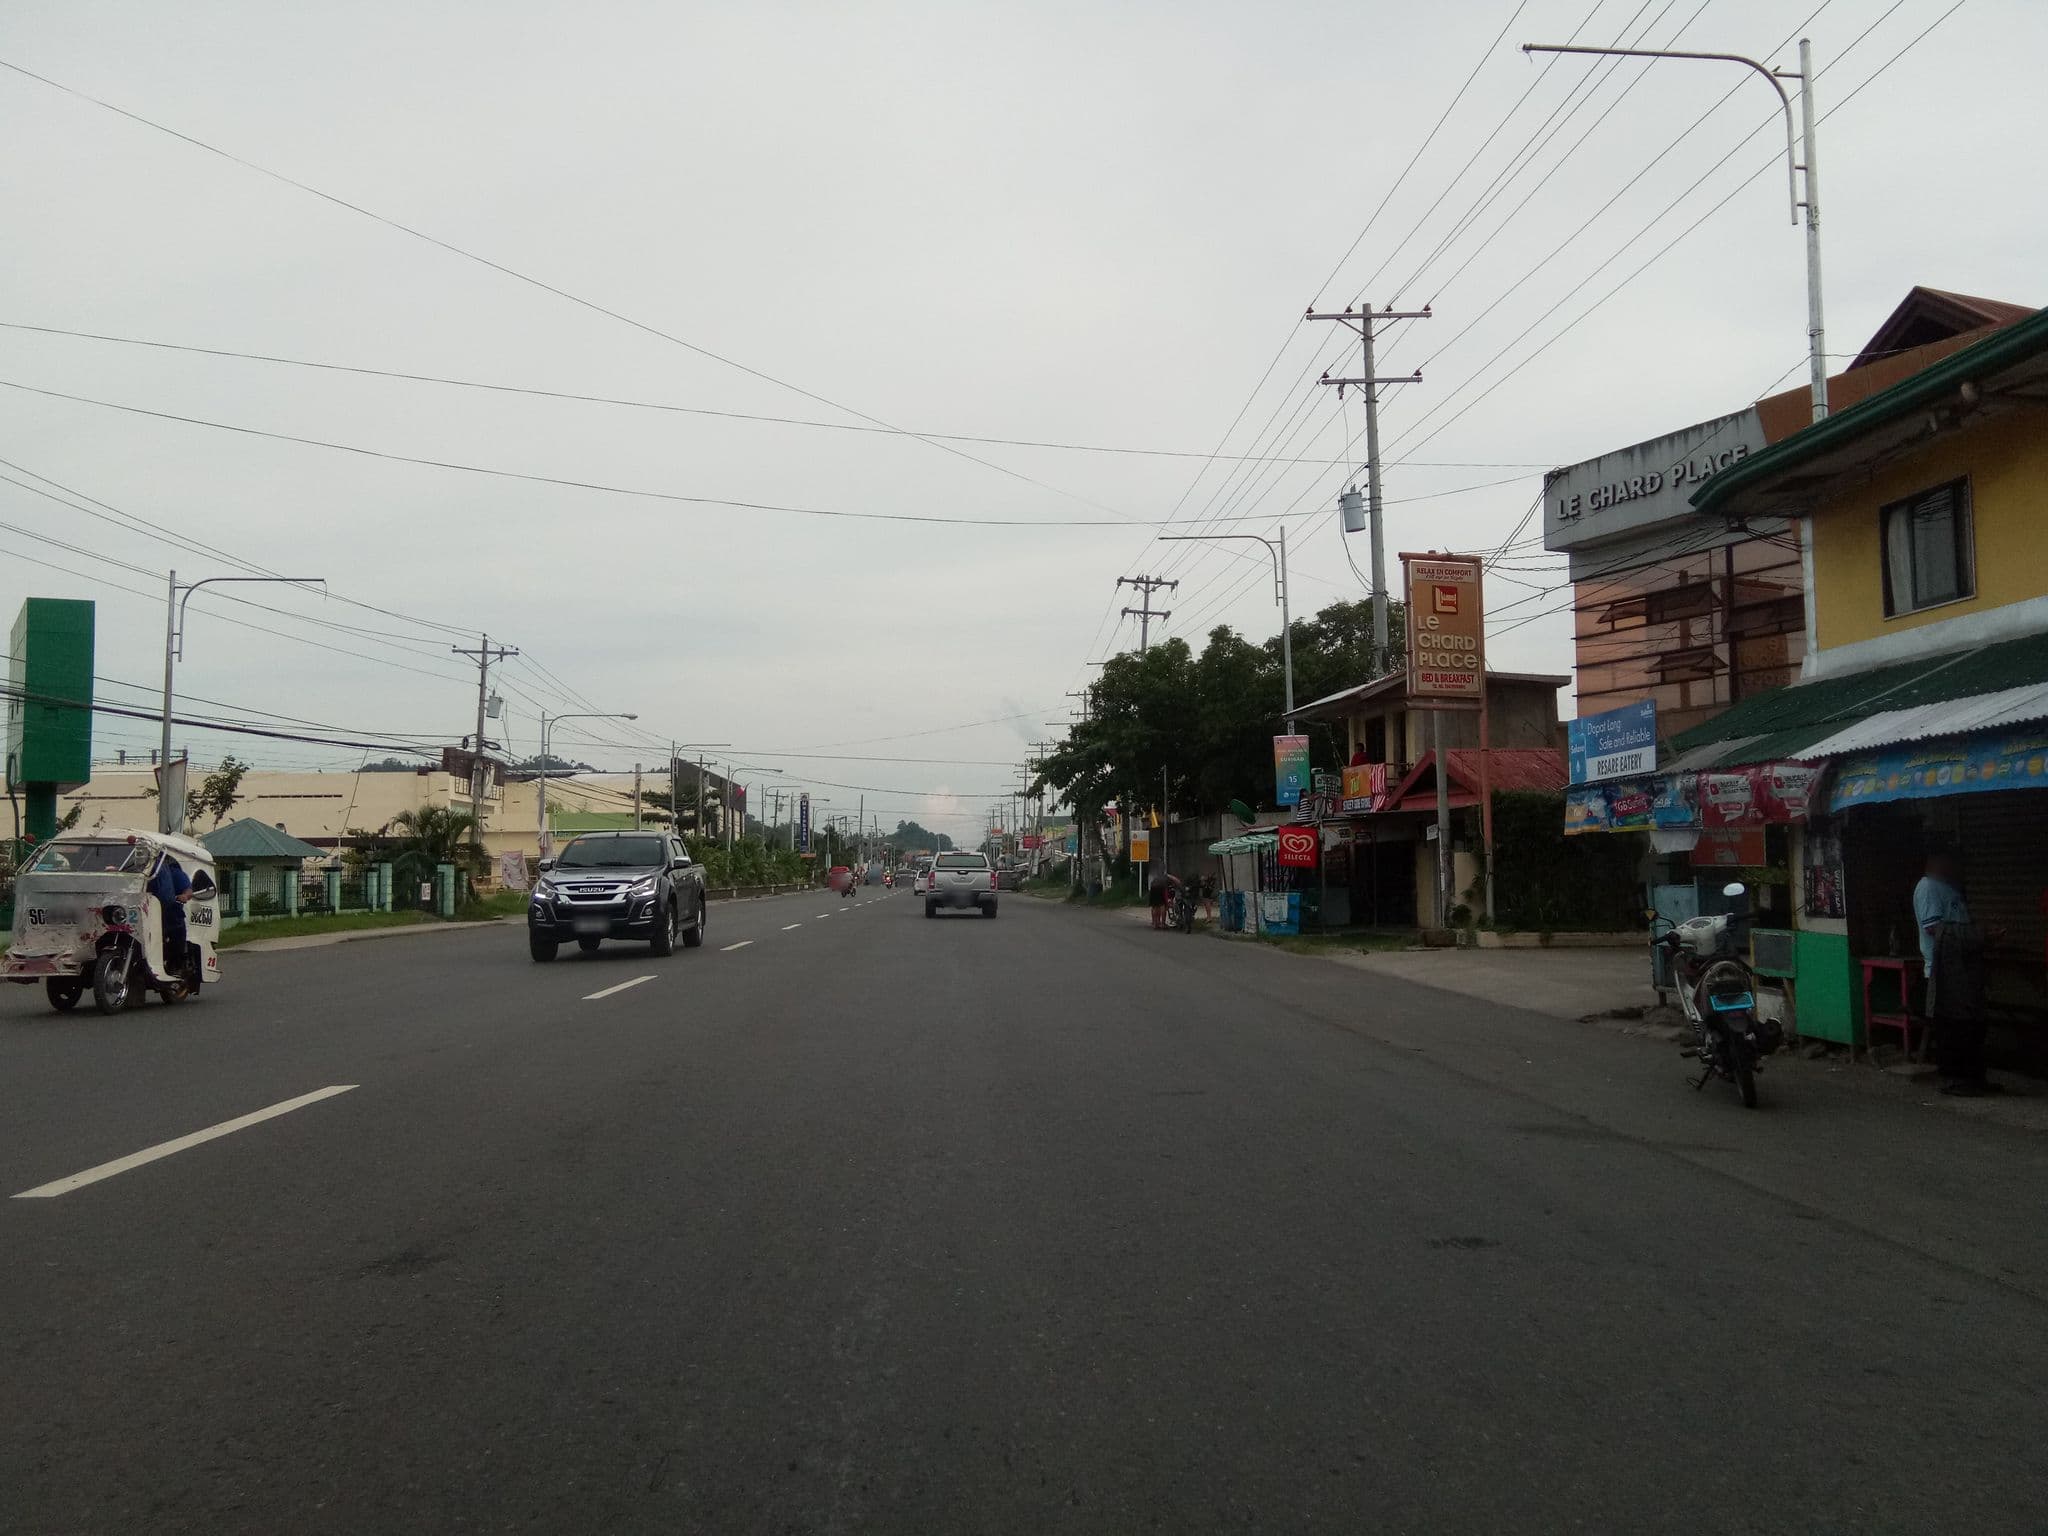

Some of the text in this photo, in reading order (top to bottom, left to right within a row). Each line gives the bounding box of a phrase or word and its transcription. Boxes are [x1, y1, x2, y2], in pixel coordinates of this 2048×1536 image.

[1556, 444, 1749, 519] LE CHARD PLACE
[1416, 567, 1435, 575] RELAX
[1444, 568, 1472, 577] COMFORT
[1421, 673, 1433, 682] BED
[1440, 673, 1475, 684] BREAKFAST
[1598, 727, 1651, 751] Safe and Reliable
[1597, 752, 1643, 776] RESARE EATERY
[1283, 853, 1312, 862] SELECTA
